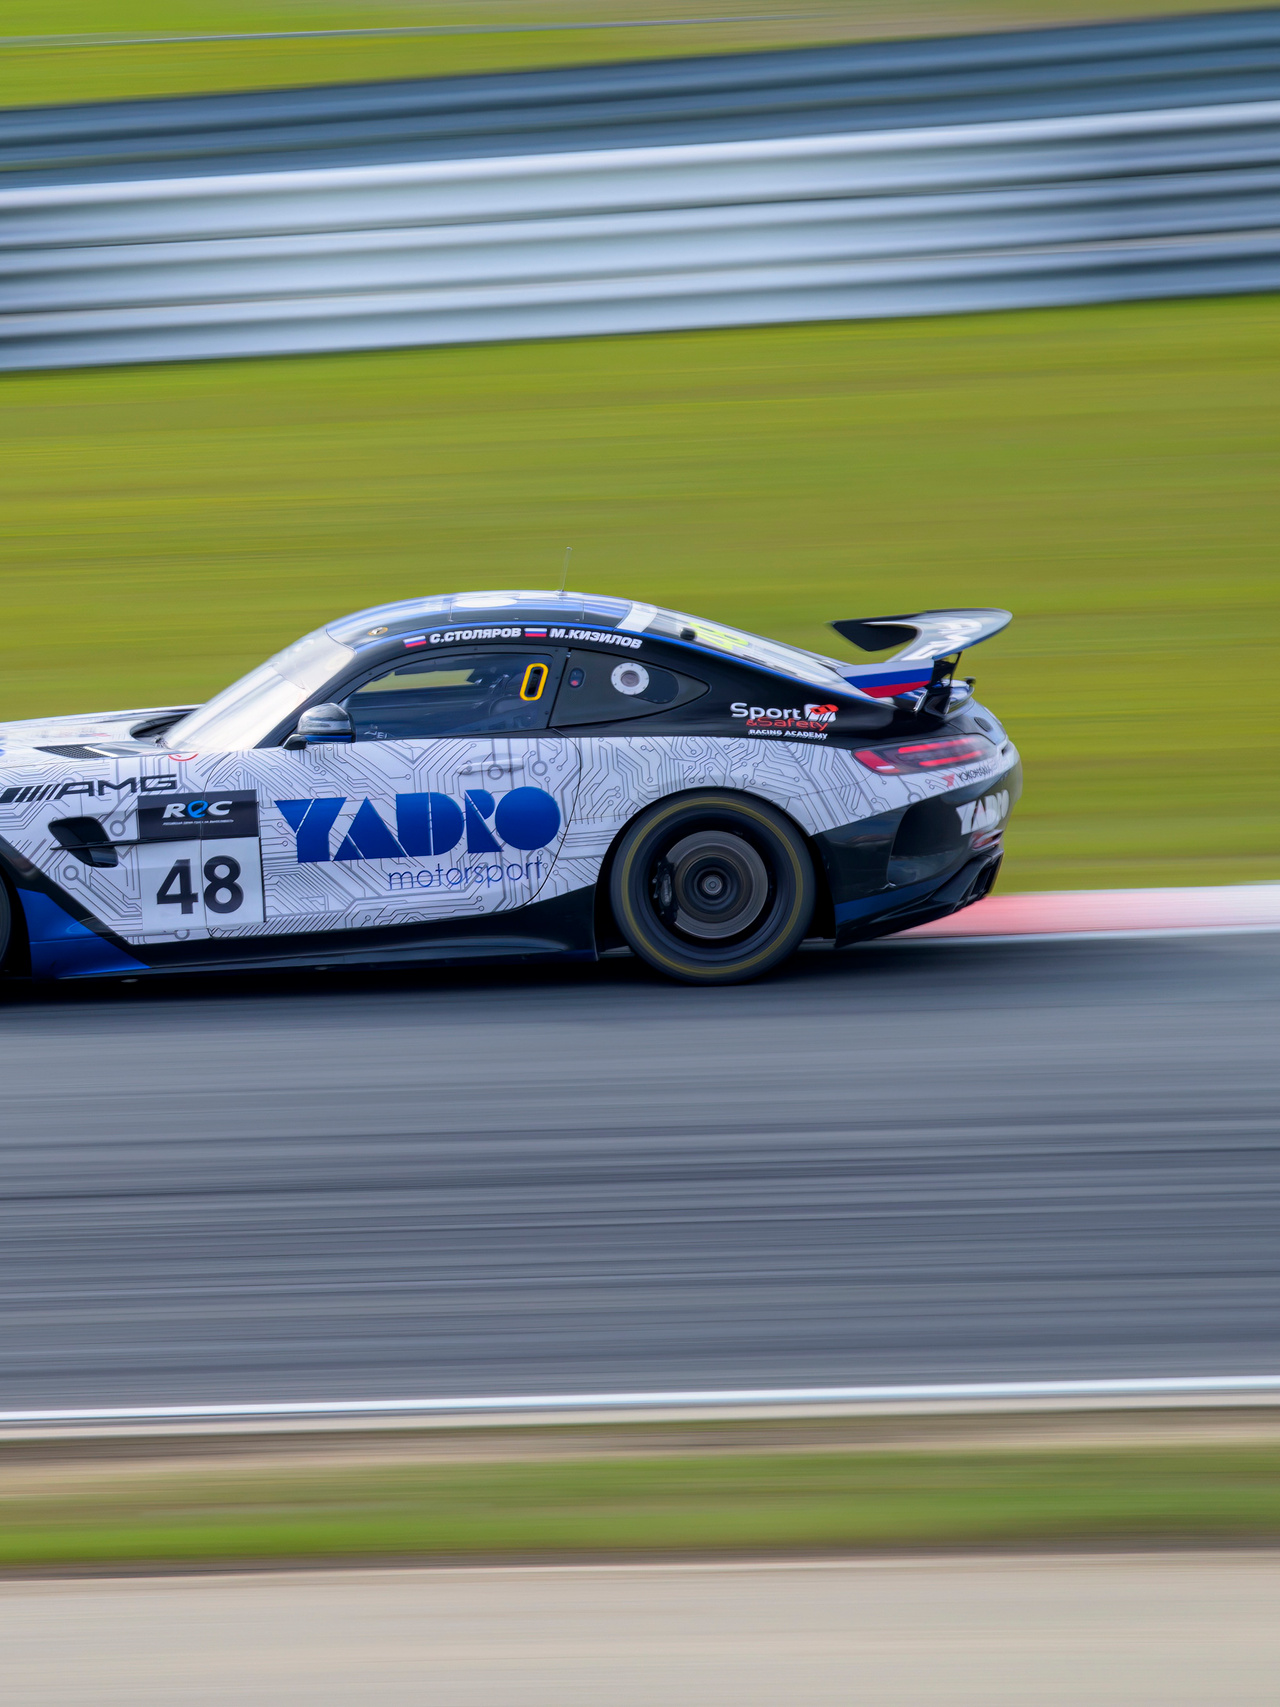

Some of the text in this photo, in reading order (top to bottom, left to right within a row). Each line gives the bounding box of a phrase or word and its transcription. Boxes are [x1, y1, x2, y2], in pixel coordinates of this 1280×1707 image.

[429, 628, 643, 649] С.СТОЛЯРОВ М.КИЗИЛОВ
[730, 702, 802, 720] Sport
[748, 729, 828, 740] RACING ACADEMY
[55, 774, 177, 799] AMG
[273, 786, 562, 863] YADRO
[156, 855, 245, 915] 48
[388, 856, 543, 890] motorsport
